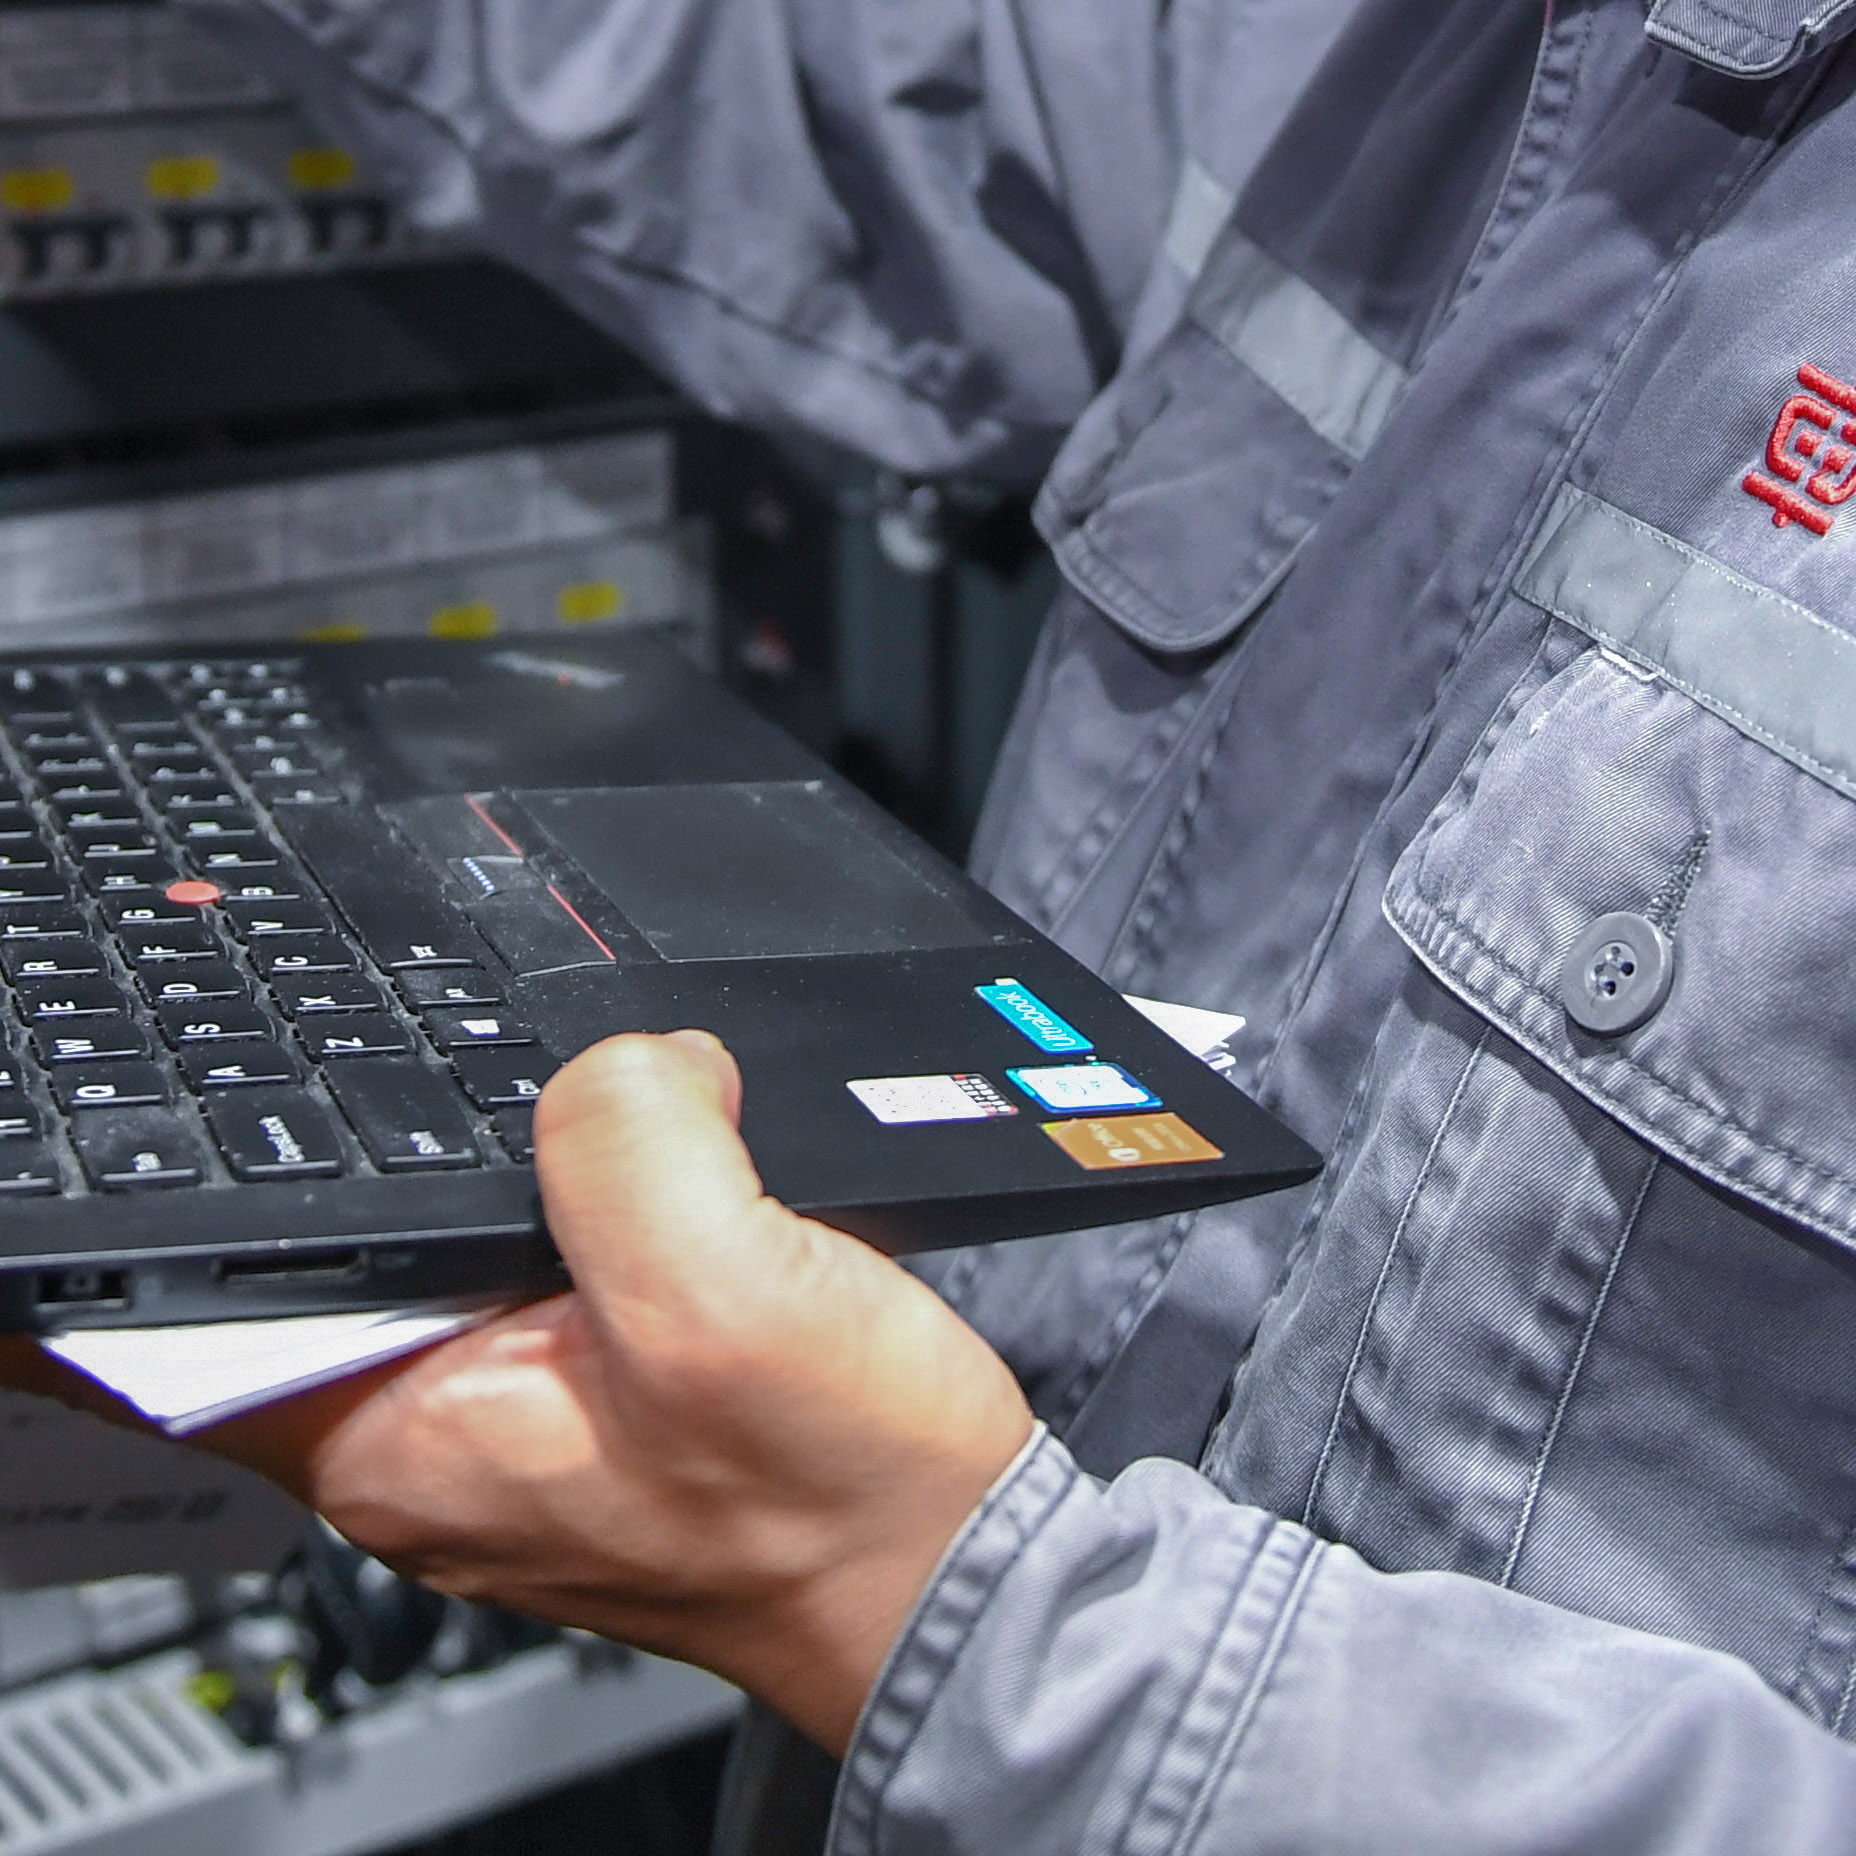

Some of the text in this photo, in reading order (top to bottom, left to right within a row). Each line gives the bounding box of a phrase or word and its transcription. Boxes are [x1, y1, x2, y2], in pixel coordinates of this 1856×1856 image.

[104, 875, 136, 886] H
[242, 886, 274, 896] B
[122, 909, 155, 919] G
[7, 924, 39, 934] T
[251, 921, 284, 931] V
[143, 945, 176, 955] F
[23, 960, 58, 972] R
[274, 956, 309, 967] C
[163, 982, 198, 994] D
[39, 1000, 76, 1012] E
[299, 995, 336, 1007] X
[999, 990, 1077, 1049] Ultrabook
[184, 1022, 220, 1035] S
[55, 1038, 94, 1054] W
[325, 1035, 363, 1048] Z
[207, 1065, 246, 1078] A
[77, 1084, 116, 1098] Q
